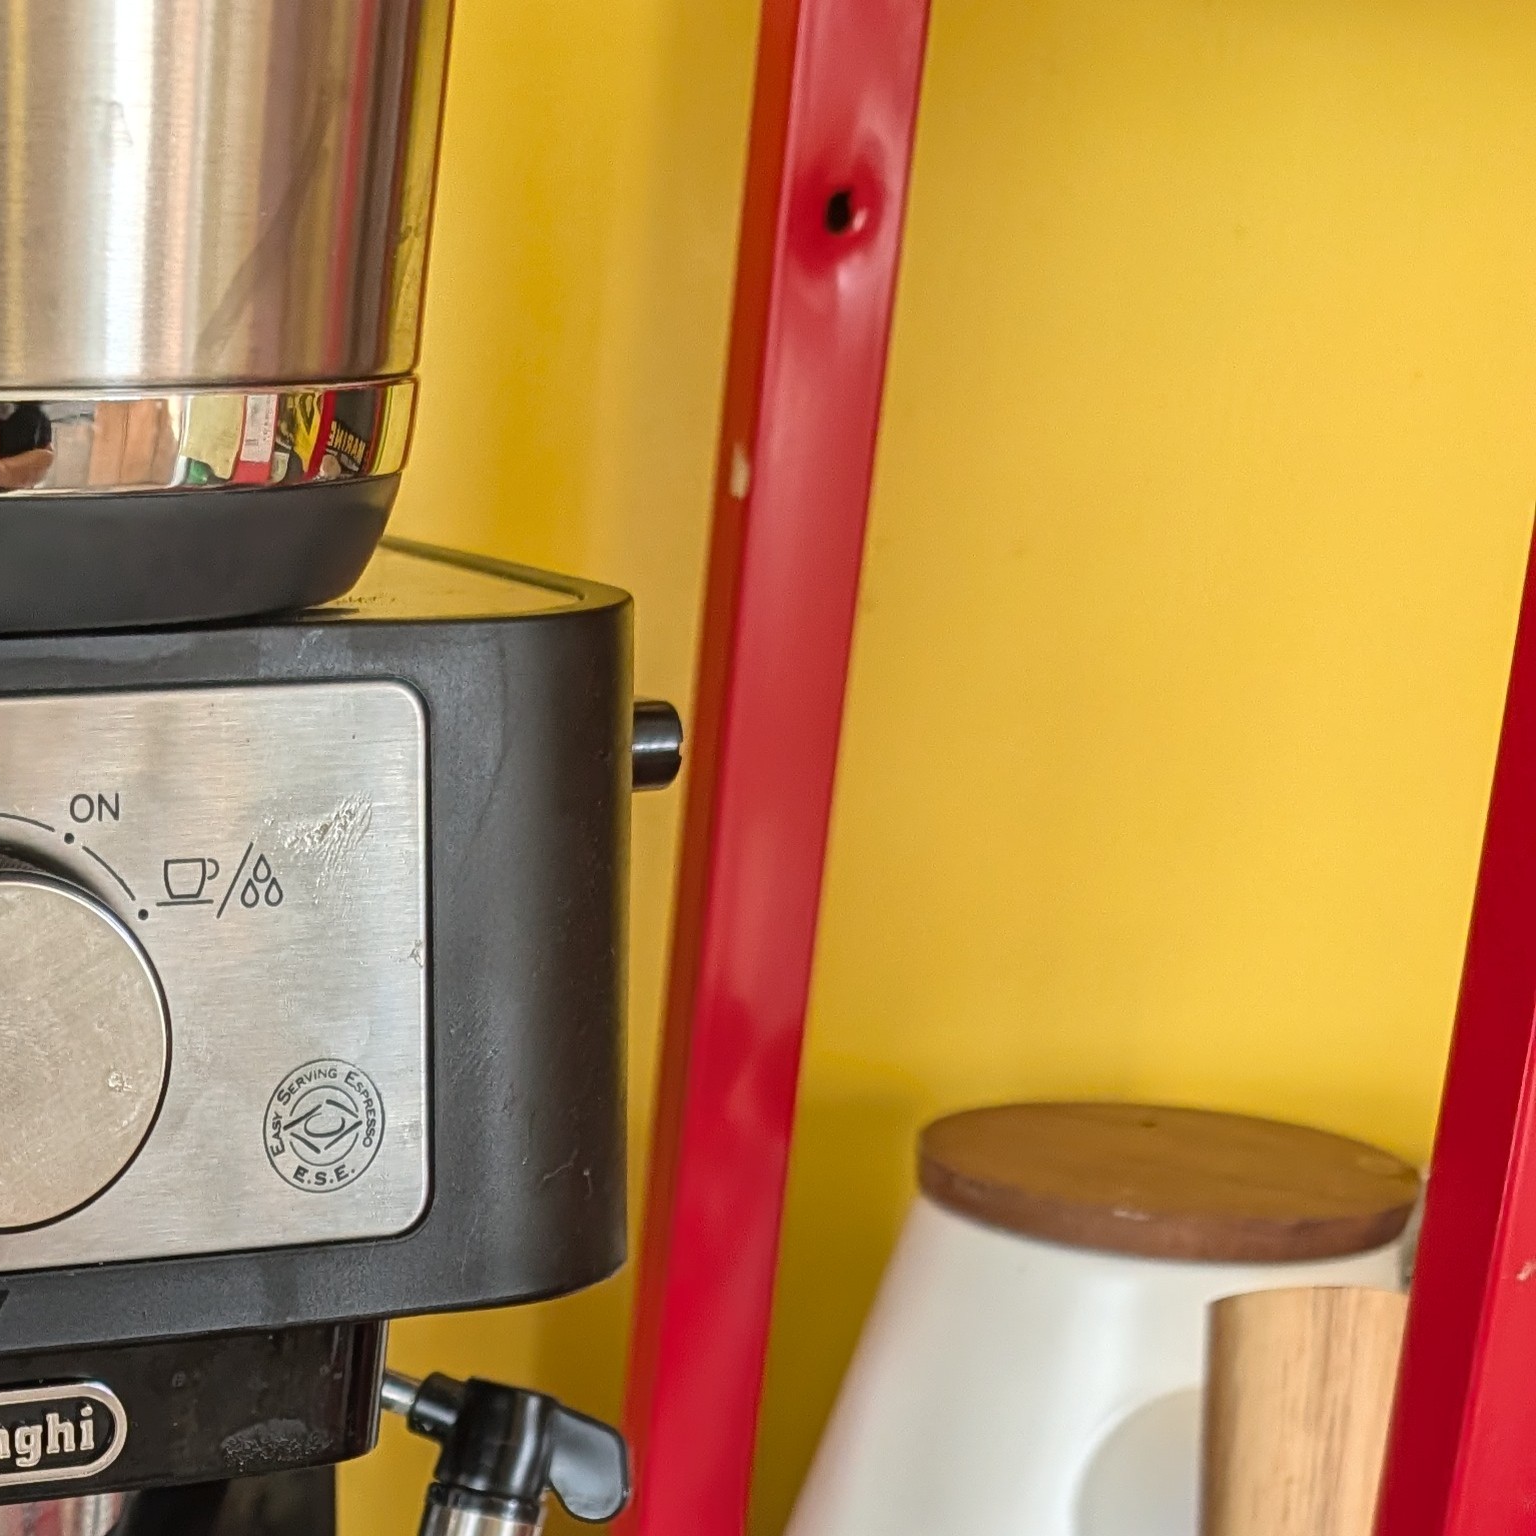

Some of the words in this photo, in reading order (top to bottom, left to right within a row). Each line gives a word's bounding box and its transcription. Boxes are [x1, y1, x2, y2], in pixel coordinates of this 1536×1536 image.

[69, 792, 120, 824] ON
[276, 1067, 339, 1107] SERVING
[344, 1070, 377, 1149] ESPRESSO
[270, 1111, 286, 1158] EASY
[292, 1163, 356, 1187] E.S.E.
